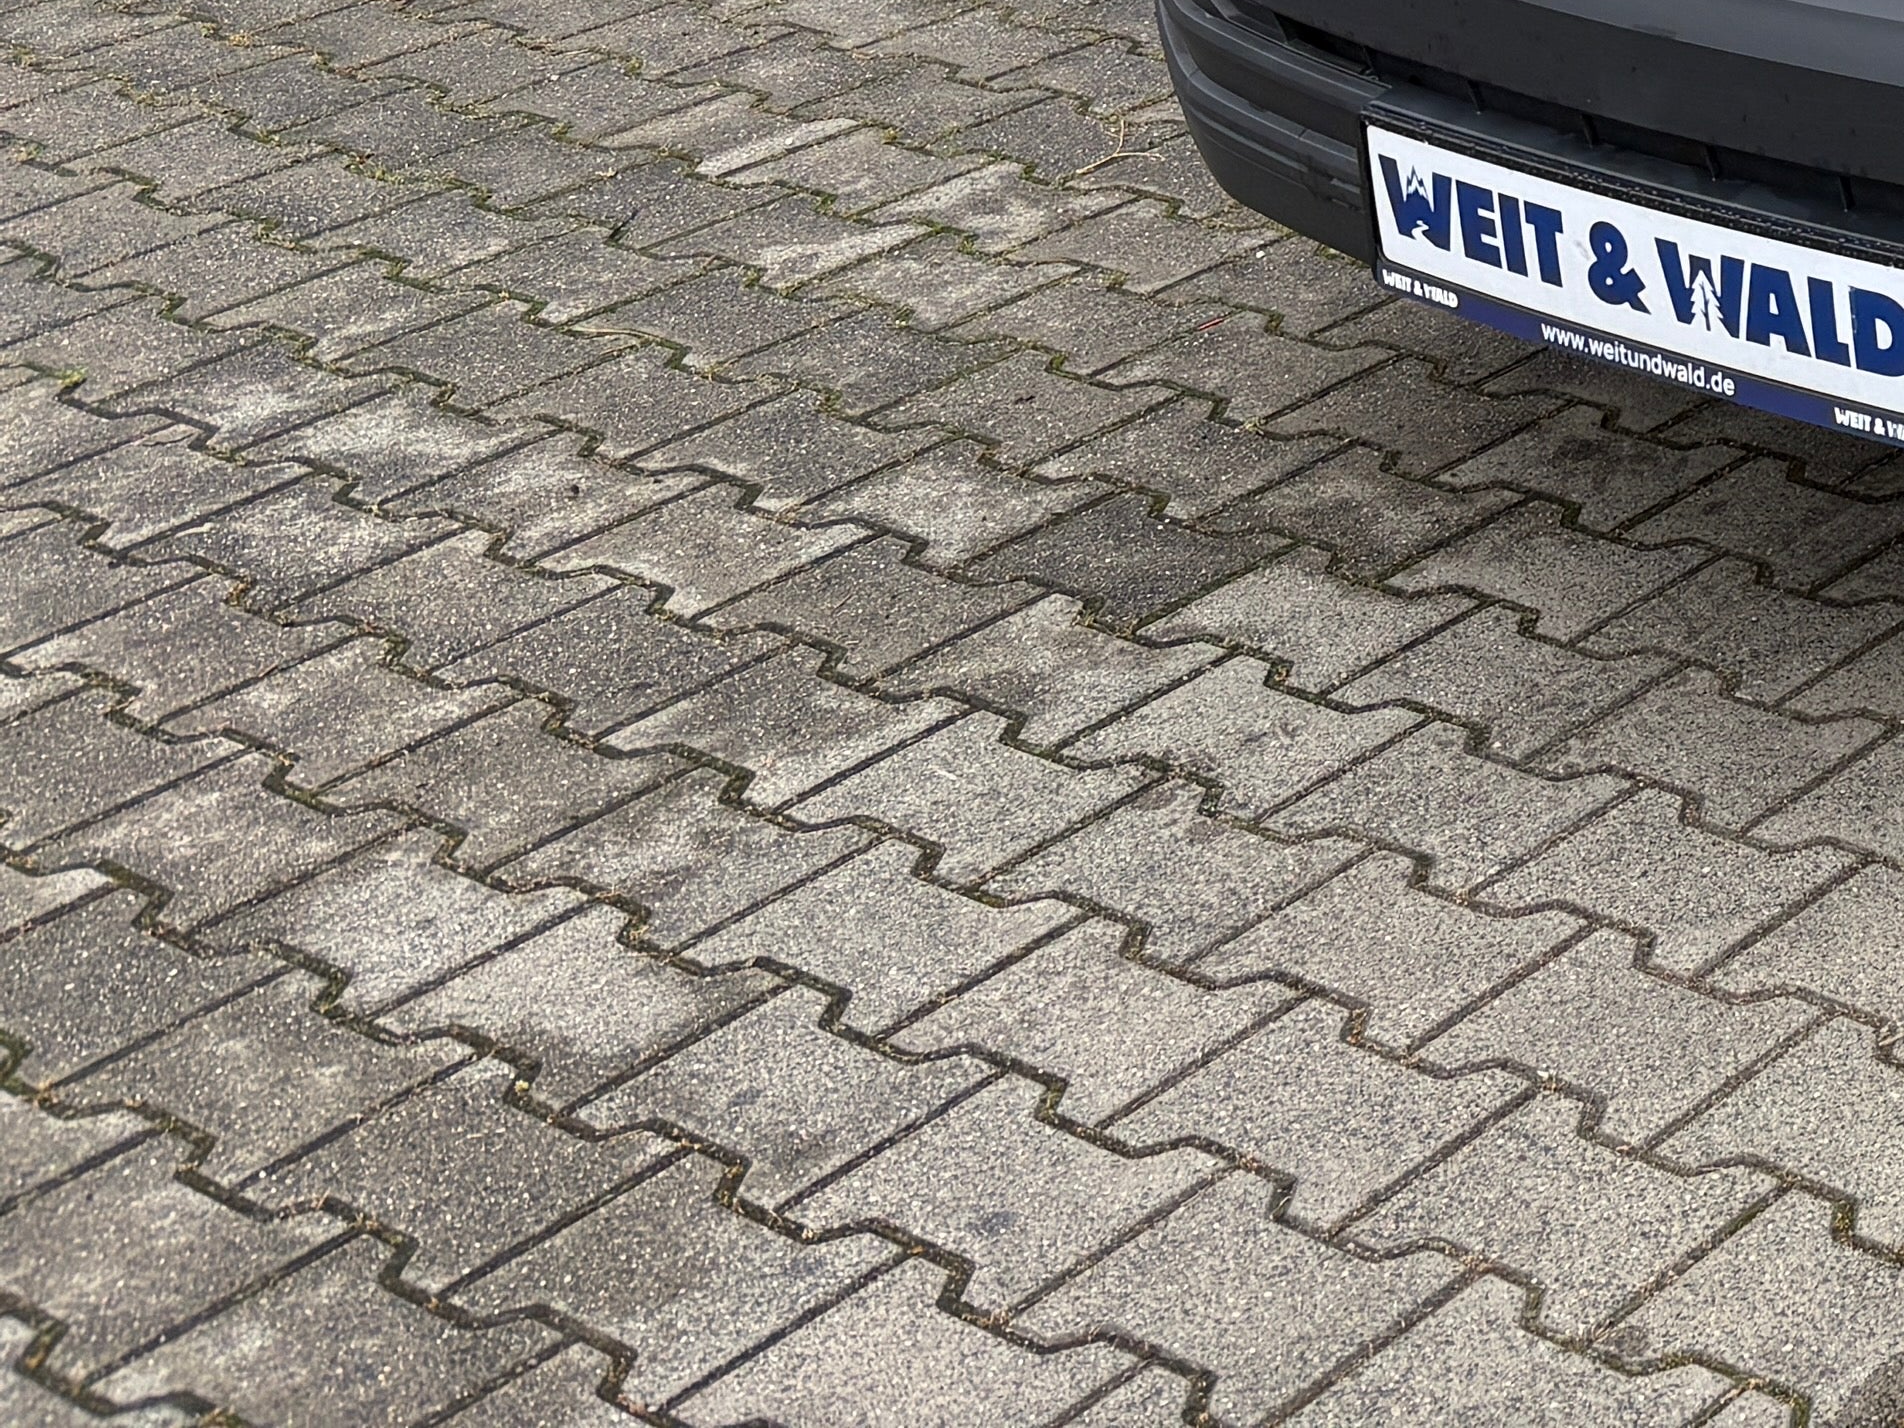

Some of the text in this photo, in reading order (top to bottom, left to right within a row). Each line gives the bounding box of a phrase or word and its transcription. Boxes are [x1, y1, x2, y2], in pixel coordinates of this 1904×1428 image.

[1378, 153, 1564, 288] WEIT
[1587, 220, 1652, 315] &
[1382, 268, 1412, 293] WEIT
[1541, 322, 1736, 396] www.weitundwald.de
[1833, 406, 1872, 432] WEIT
[1873, 417, 1886, 436] &
